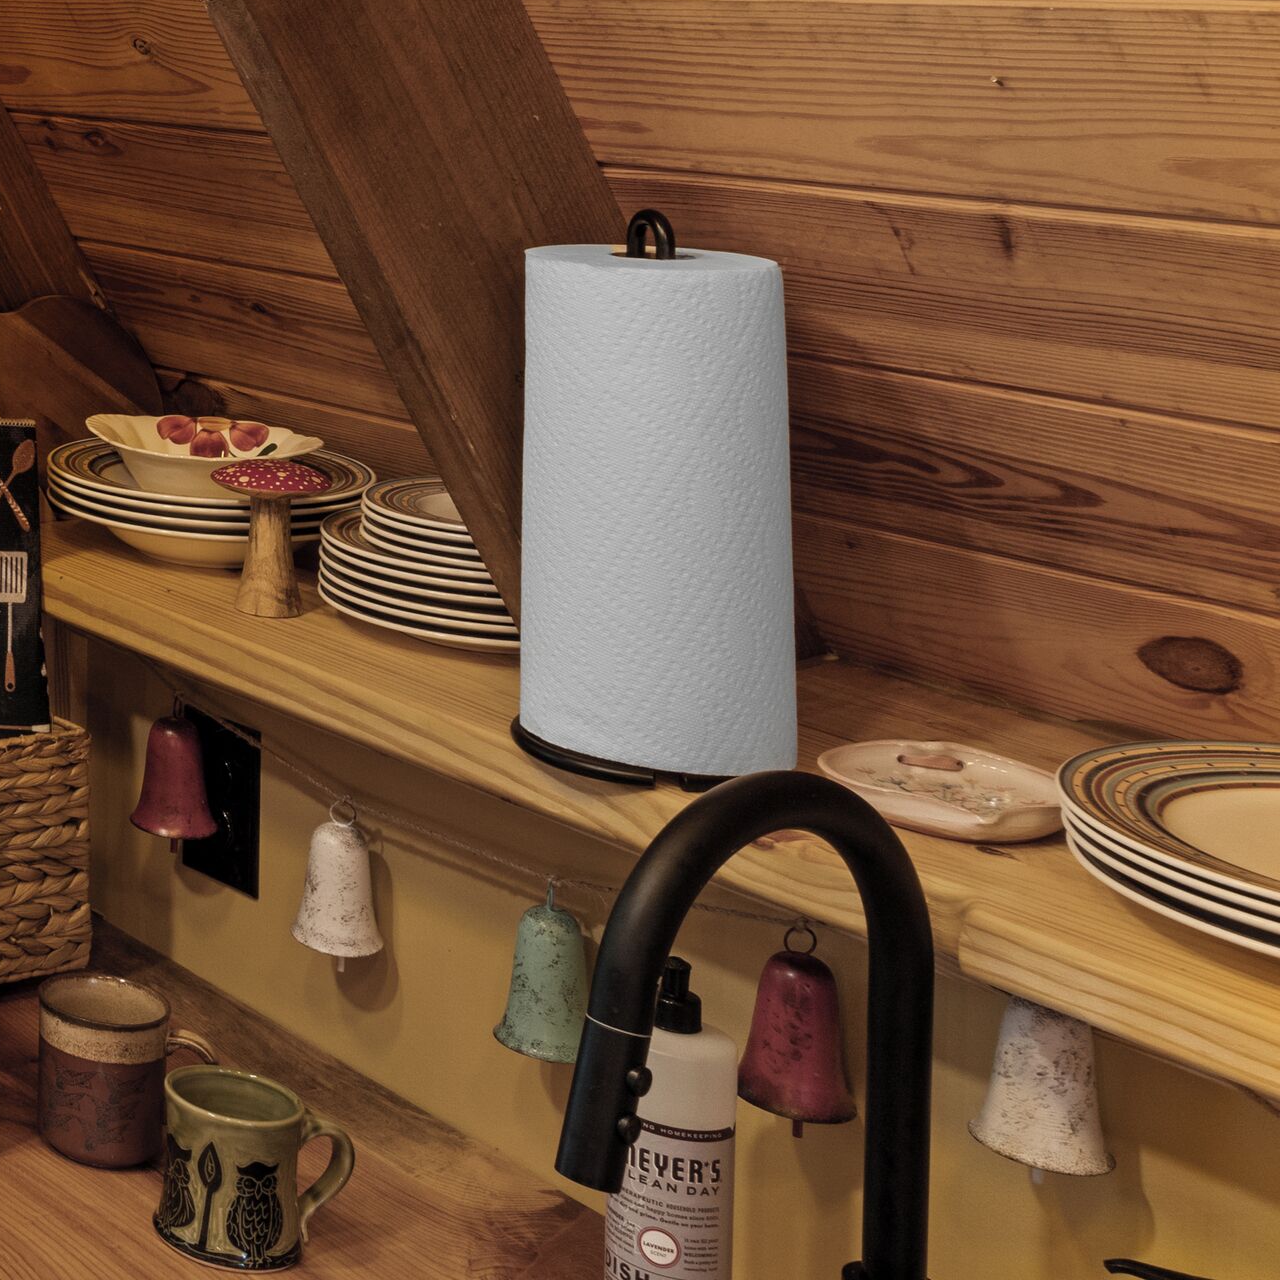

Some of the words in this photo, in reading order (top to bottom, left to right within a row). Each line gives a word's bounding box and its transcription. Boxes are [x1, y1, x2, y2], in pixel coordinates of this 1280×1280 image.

[660, 1127, 722, 1139] HOMEKEEPING
[628, 1169, 678, 1194] LEAN
[686, 1186, 720, 1196] DAY
[642, 1240, 675, 1254] LAVENDER
[606, 1248, 650, 1280] DISH
